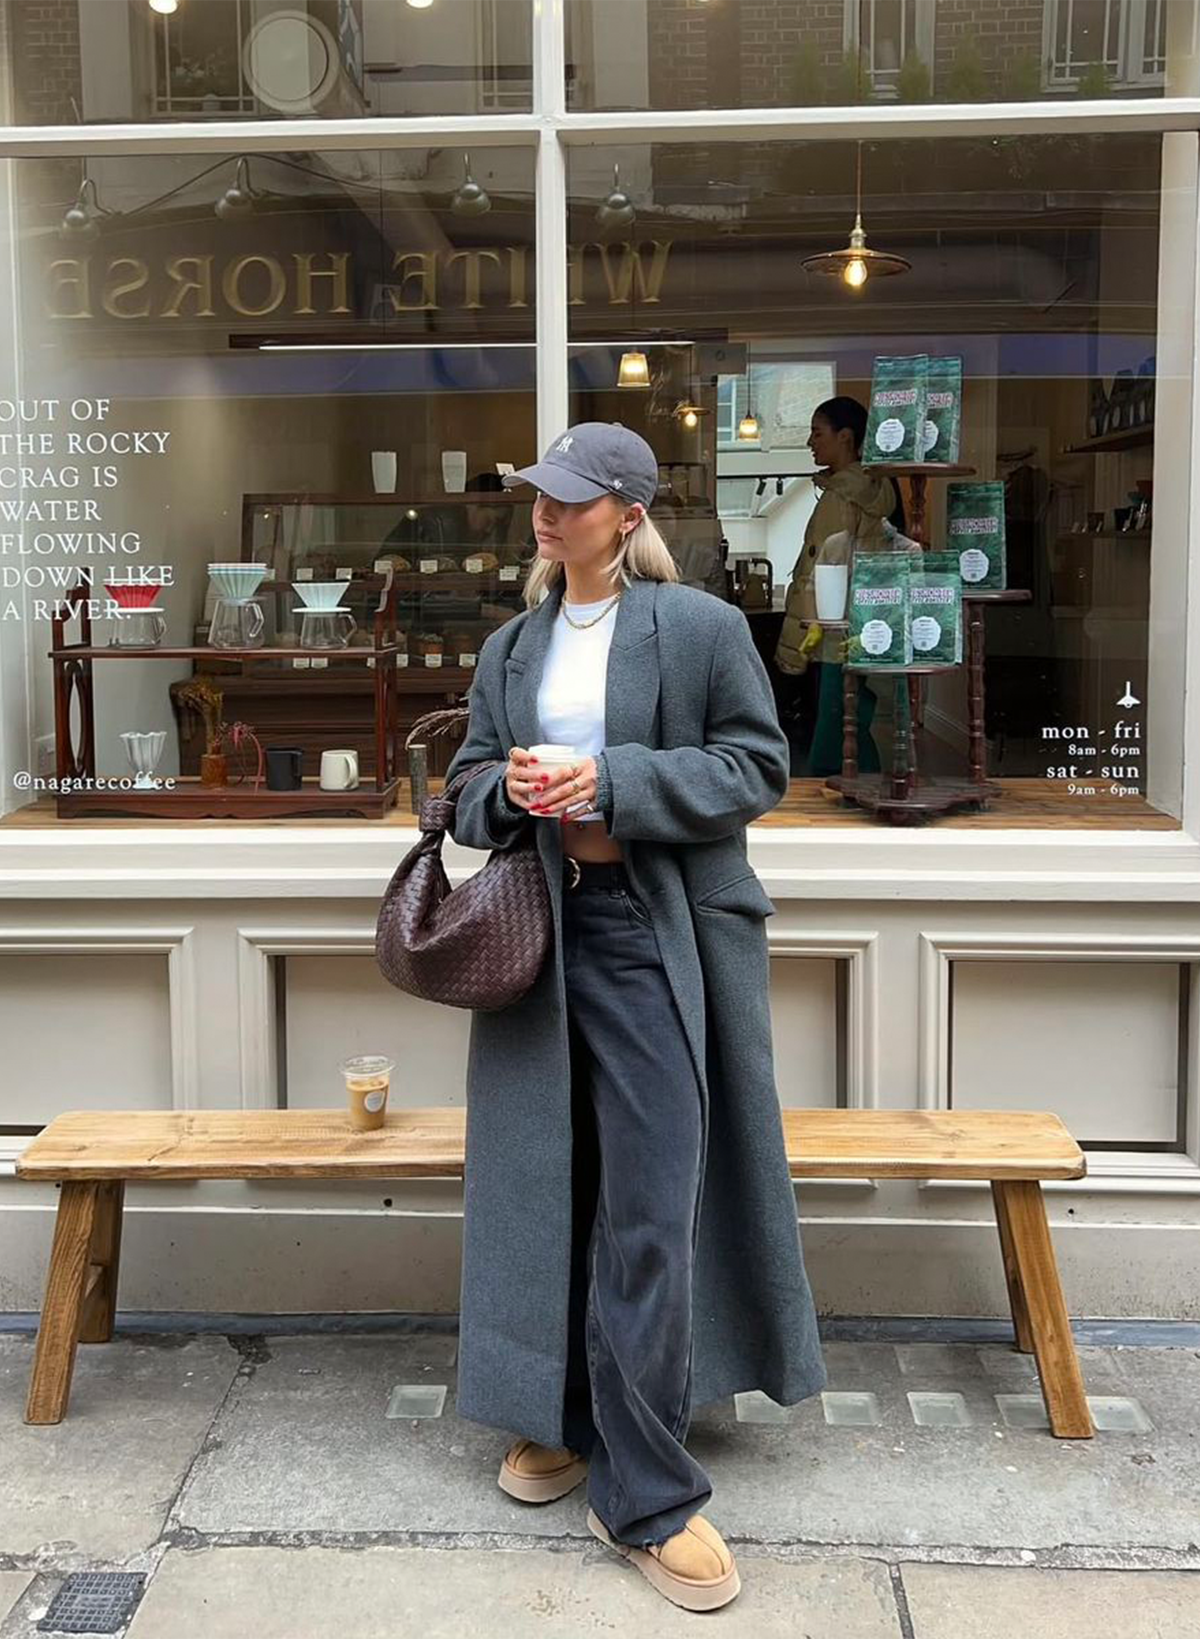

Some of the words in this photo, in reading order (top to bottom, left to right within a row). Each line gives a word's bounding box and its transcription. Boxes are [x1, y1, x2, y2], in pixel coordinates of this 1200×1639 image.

[0, 399, 59, 422] OUT
[71, 399, 110, 422] OF
[0, 433, 55, 455] THE
[67, 432, 170, 455] ROCKY
[0, 466, 80, 489] CRAG
[92, 466, 118, 488] IS
[0, 499, 102, 522] WATER
[1, 532, 141, 555] FLOWING
[3, 566, 95, 588] DOWN
[108, 565, 175, 587] LIKE
[2, 599, 21, 621] A
[33, 599, 132, 621] RIVER.
[1042, 726, 1090, 739] mon
[1114, 720, 1141, 739] fri
[1068, 743, 1097, 756] 8am
[1110, 743, 1140, 758] 6pm
[13, 771, 176, 794] @nagarecoffee
[1046, 765, 1078, 779] sat
[1101, 765, 1139, 779] sun
[1067, 783, 1096, 796] 9am
[1109, 783, 1140, 797] 6pm
